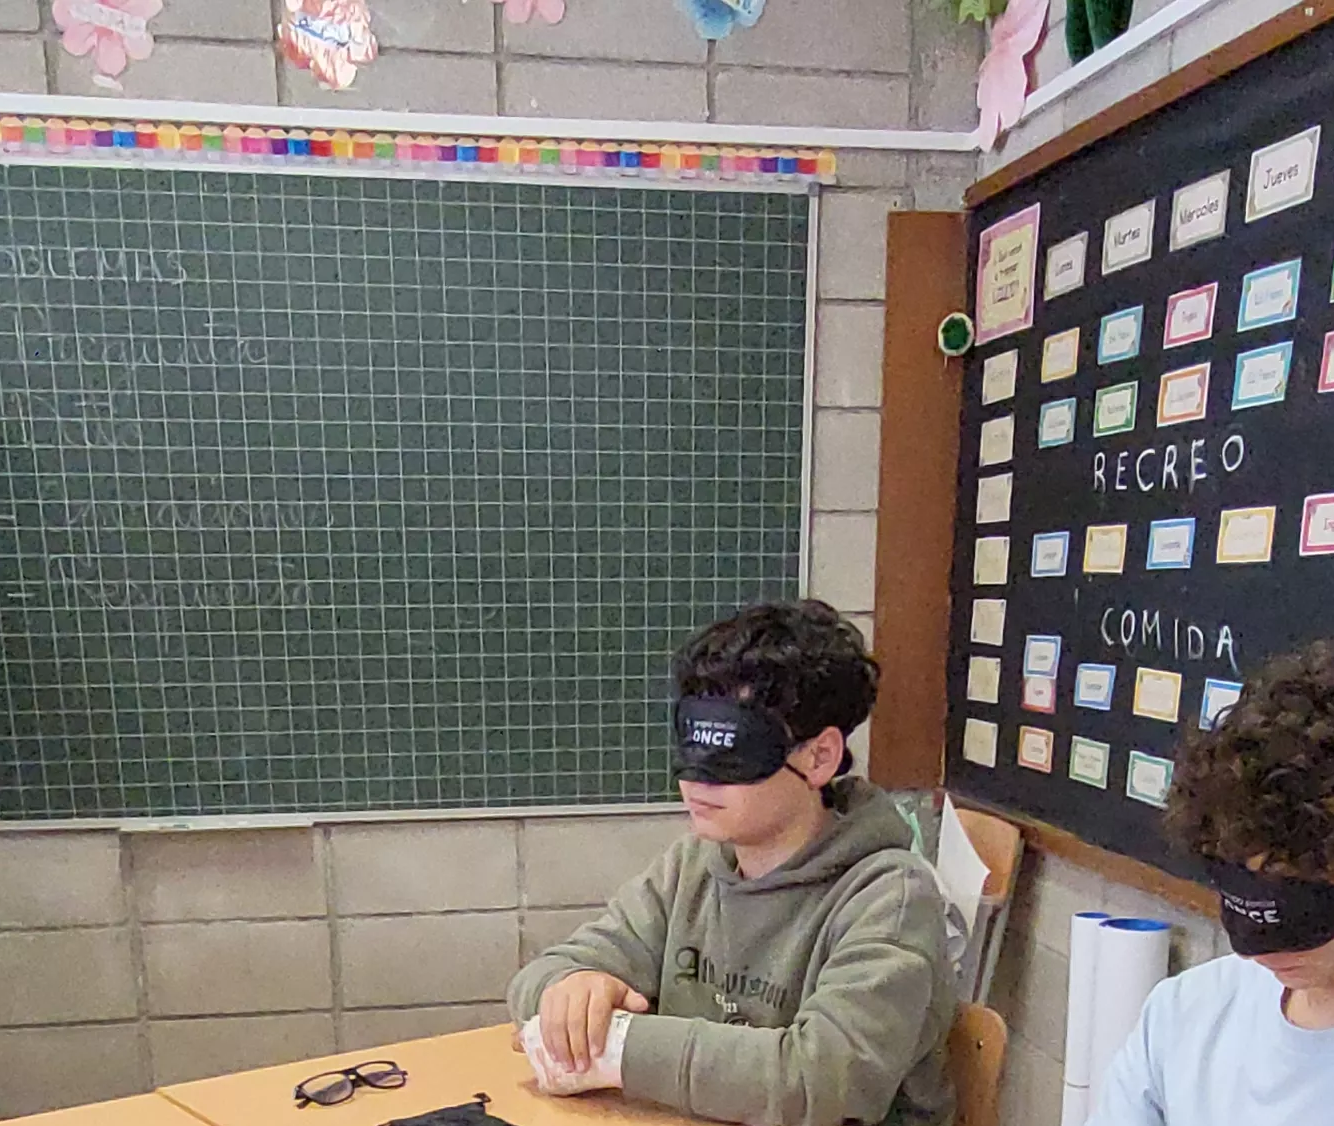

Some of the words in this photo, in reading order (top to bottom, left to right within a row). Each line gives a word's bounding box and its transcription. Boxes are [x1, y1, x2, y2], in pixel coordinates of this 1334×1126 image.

[1263, 163, 1299, 190] Jueves
[1093, 434, 1245, 494] RECREO
[1099, 607, 1240, 675] COMIDA
[692, 729, 736, 748] ONCE
